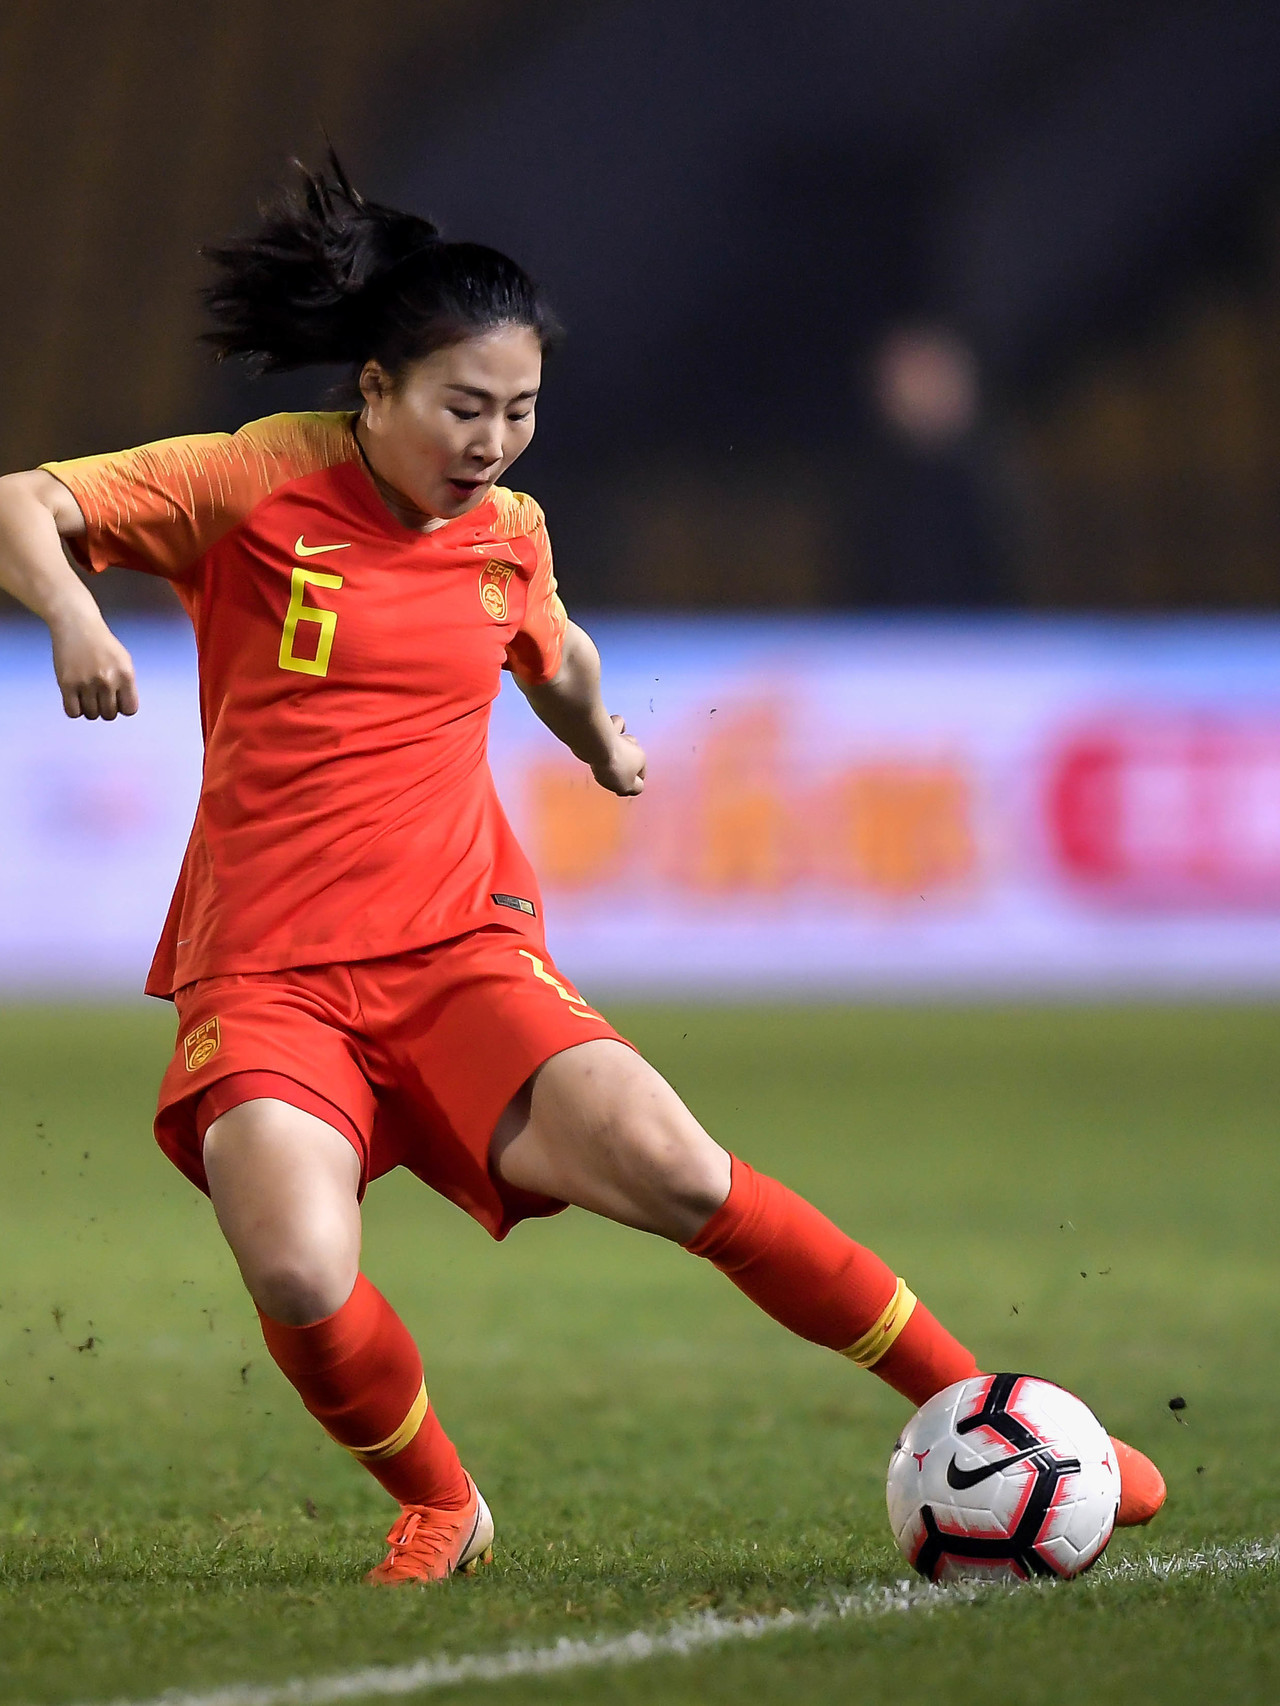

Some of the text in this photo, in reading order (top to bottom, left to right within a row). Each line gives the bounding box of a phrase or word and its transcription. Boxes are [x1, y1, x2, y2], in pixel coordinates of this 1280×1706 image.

[486, 562, 512, 579] CFA
[278, 567, 344, 677] 6
[187, 1020, 216, 1046] CFA
